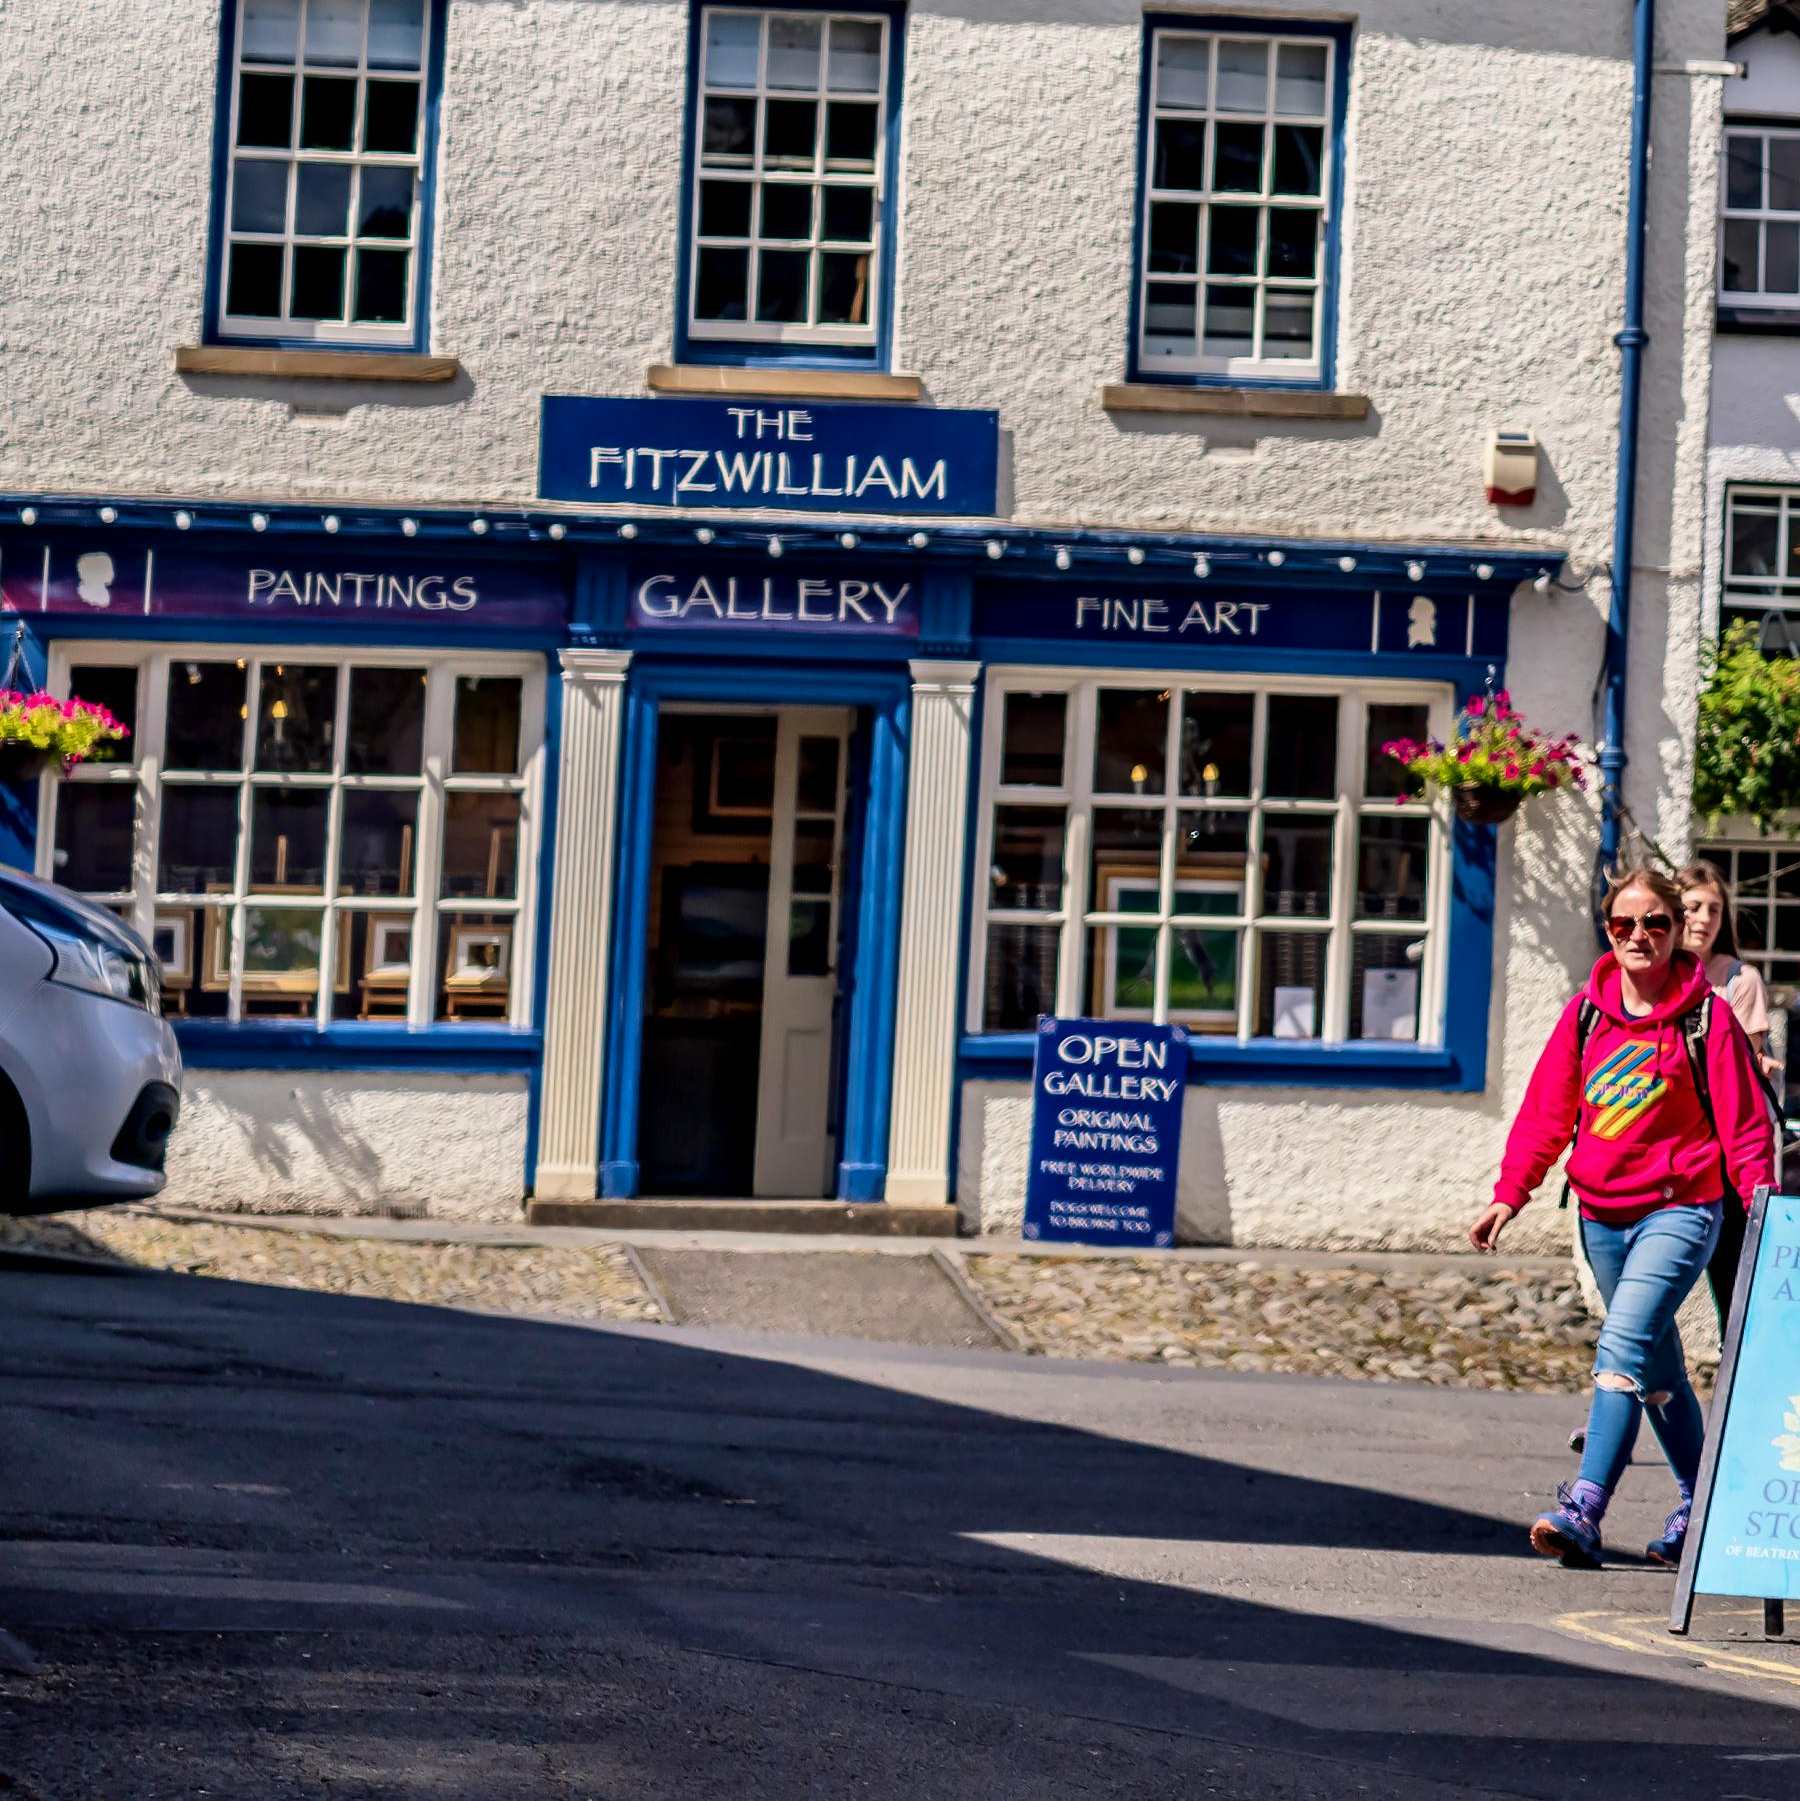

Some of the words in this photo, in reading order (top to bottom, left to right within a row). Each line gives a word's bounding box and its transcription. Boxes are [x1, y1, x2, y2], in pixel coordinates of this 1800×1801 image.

[726, 406, 814, 442] THE
[588, 446, 946, 501] FITZWILLIAM
[247, 568, 479, 612] PAINTINGS
[636, 573, 912, 625] GALLERY
[1075, 596, 1171, 633] FINE
[1177, 600, 1272, 637] ART
[1057, 1034, 1168, 1069] OPEN
[1043, 1071, 1179, 1102] GALLERY
[1057, 1108, 1157, 1133] ORIGINAL
[1053, 1129, 1159, 1154] PAINTINGS
[1040, 1159, 1077, 1176] FREE
[1079, 1162, 1165, 1182] WORLDWIDE
[1067, 1176, 1136, 1193] DELIVERY
[1725, 1545, 1744, 1557] OF
[1746, 1546, 1800, 1561] BEATRIX
